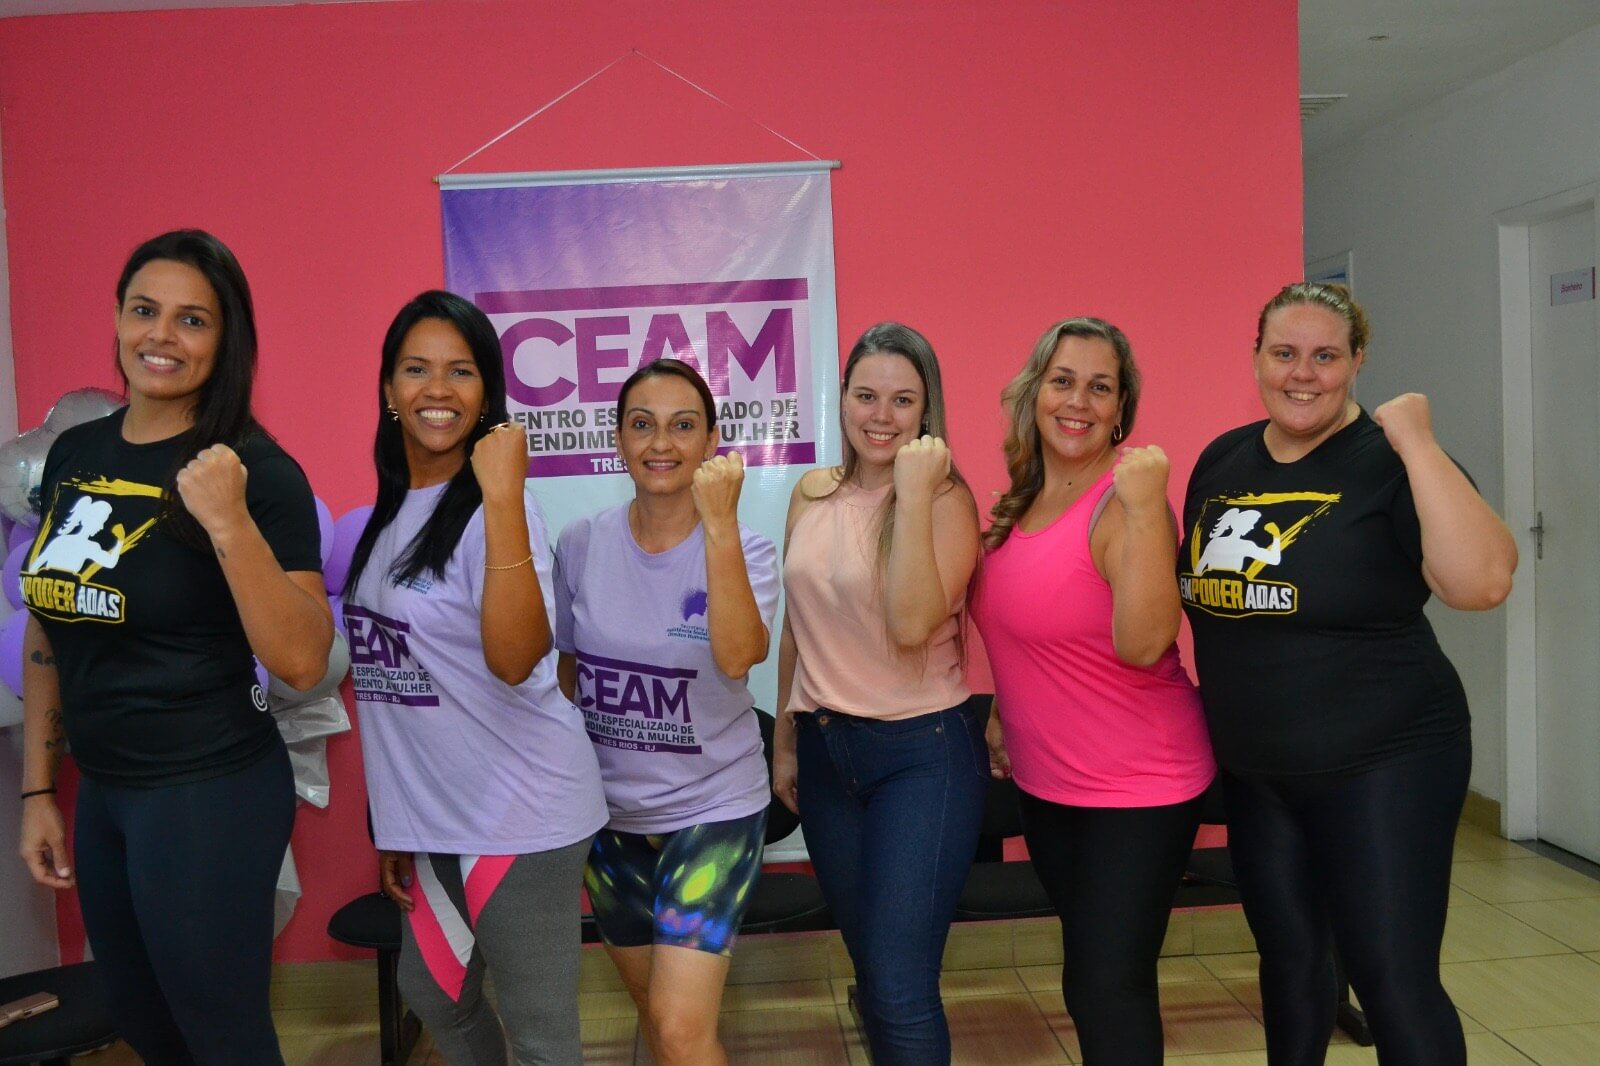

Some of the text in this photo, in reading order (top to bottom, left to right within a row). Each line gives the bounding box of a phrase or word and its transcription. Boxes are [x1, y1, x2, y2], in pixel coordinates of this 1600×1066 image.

[500, 307, 797, 407] CEAM
[513, 409, 587, 430] ENTRO
[771, 399, 798, 418] DE
[721, 420, 801, 443] ULHER
[1180, 576, 1293, 610] EMPODERADAS
[576, 663, 692, 724] CEAM
[601, 714, 678, 733] ESPECIALIZADO
[680, 725, 695, 735] DE
[618, 741, 638, 750] RIOS
[644, 744, 656, 752] RJ
[647, 732, 696, 745] MULHER
